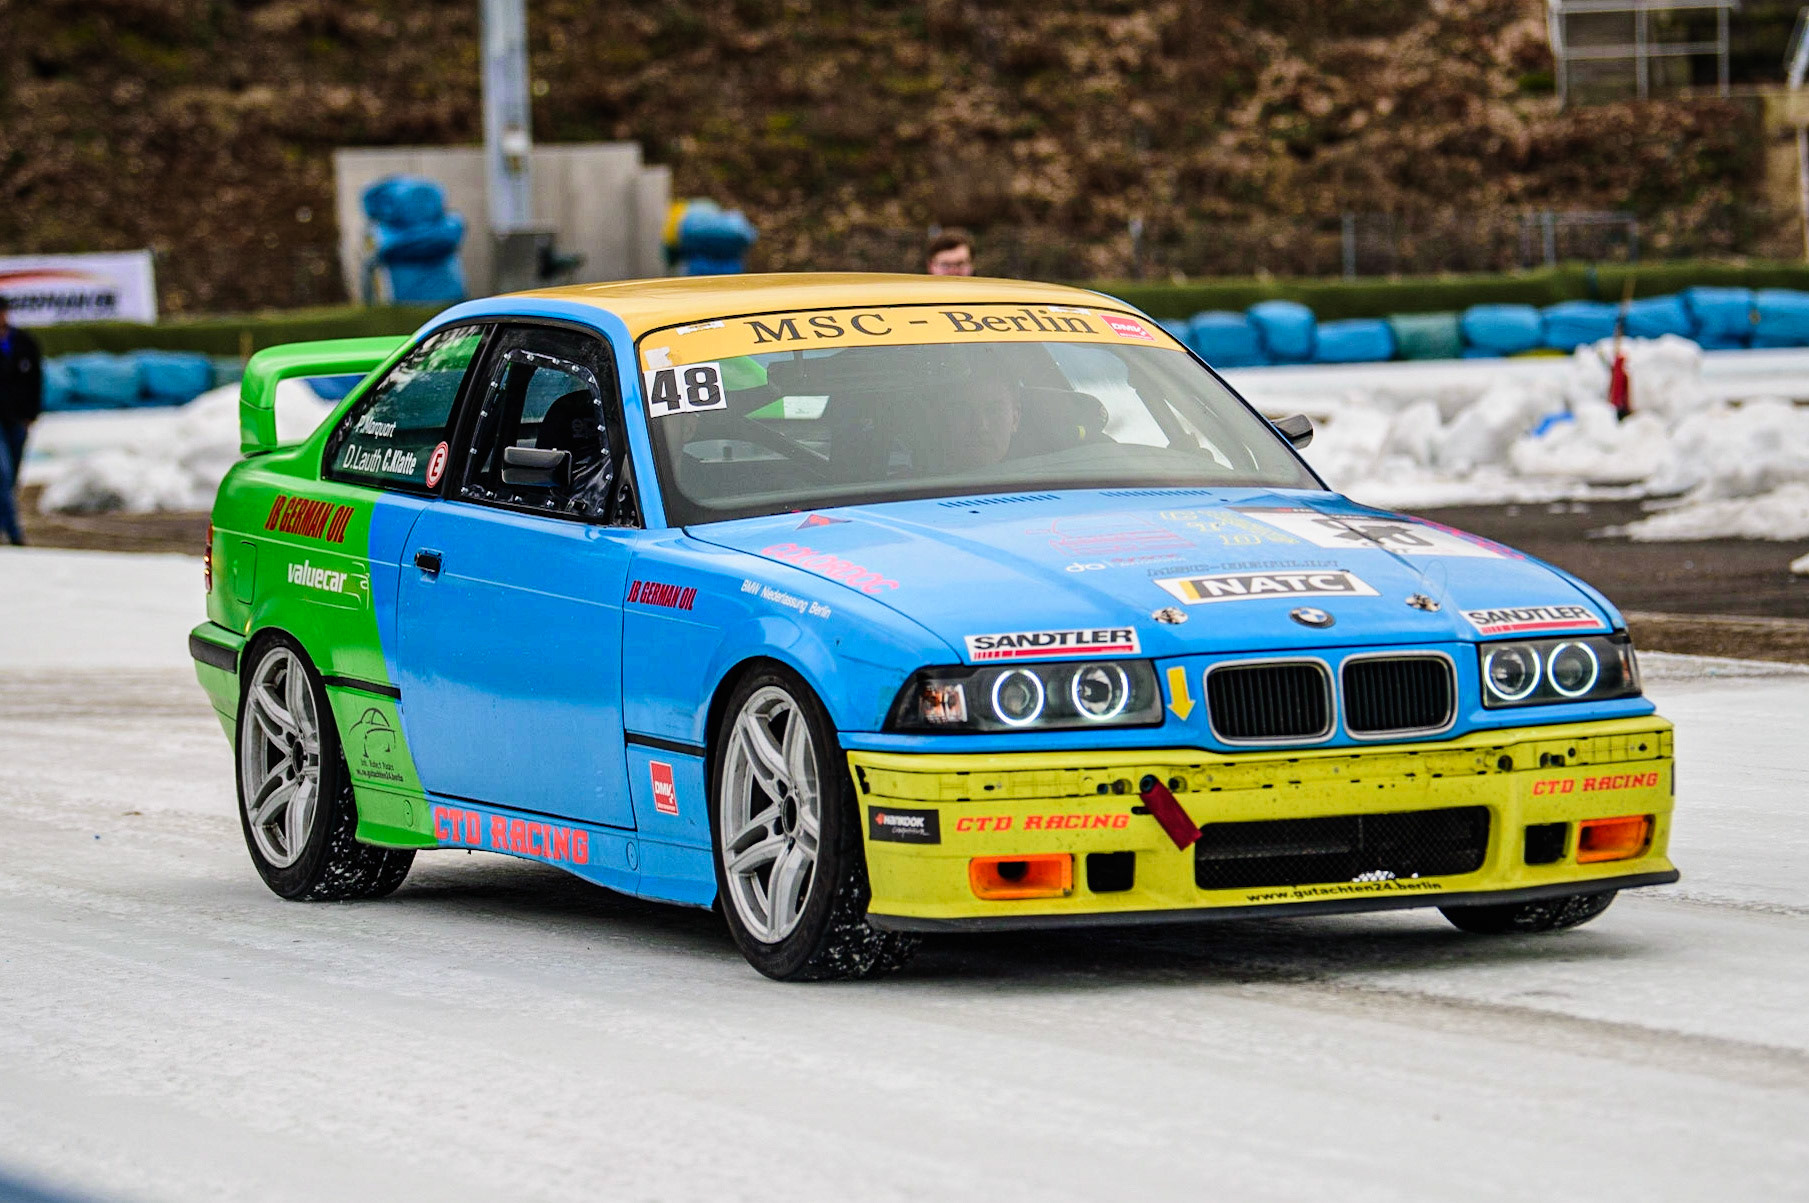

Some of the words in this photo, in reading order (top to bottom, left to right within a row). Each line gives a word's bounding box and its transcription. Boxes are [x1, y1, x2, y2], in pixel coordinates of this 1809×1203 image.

[743, 314, 892, 344] MSC
[939, 308, 1099, 334] Berlin
[651, 366, 721, 411] 48
[343, 444, 382, 473] D.Lauth
[382, 448, 417, 475] C.Klatte
[431, 454, 442, 476] E
[279, 497, 335, 539] GERMAN
[326, 505, 354, 543] OIL
[287, 560, 347, 593] valuecar
[1202, 575, 1345, 596] NATC
[640, 582, 682, 608] GERMAN
[678, 587, 698, 611] OIL
[741, 579, 762, 595] BMW
[761, 586, 808, 614] Niederlassung
[808, 601, 832, 619] Berlin
[1468, 606, 1592, 625] SANDTLER
[974, 629, 1132, 650] SANDTLER
[654, 781, 672, 797] DMV
[1532, 779, 1574, 796] CTD
[1582, 772, 1659, 792] RACING
[434, 806, 481, 845] CTD
[491, 815, 589, 865] RACING
[956, 816, 1014, 832] CTD
[1024, 814, 1130, 830] RACING
[1247, 881, 1442, 902] www.gutachten24.berlin
